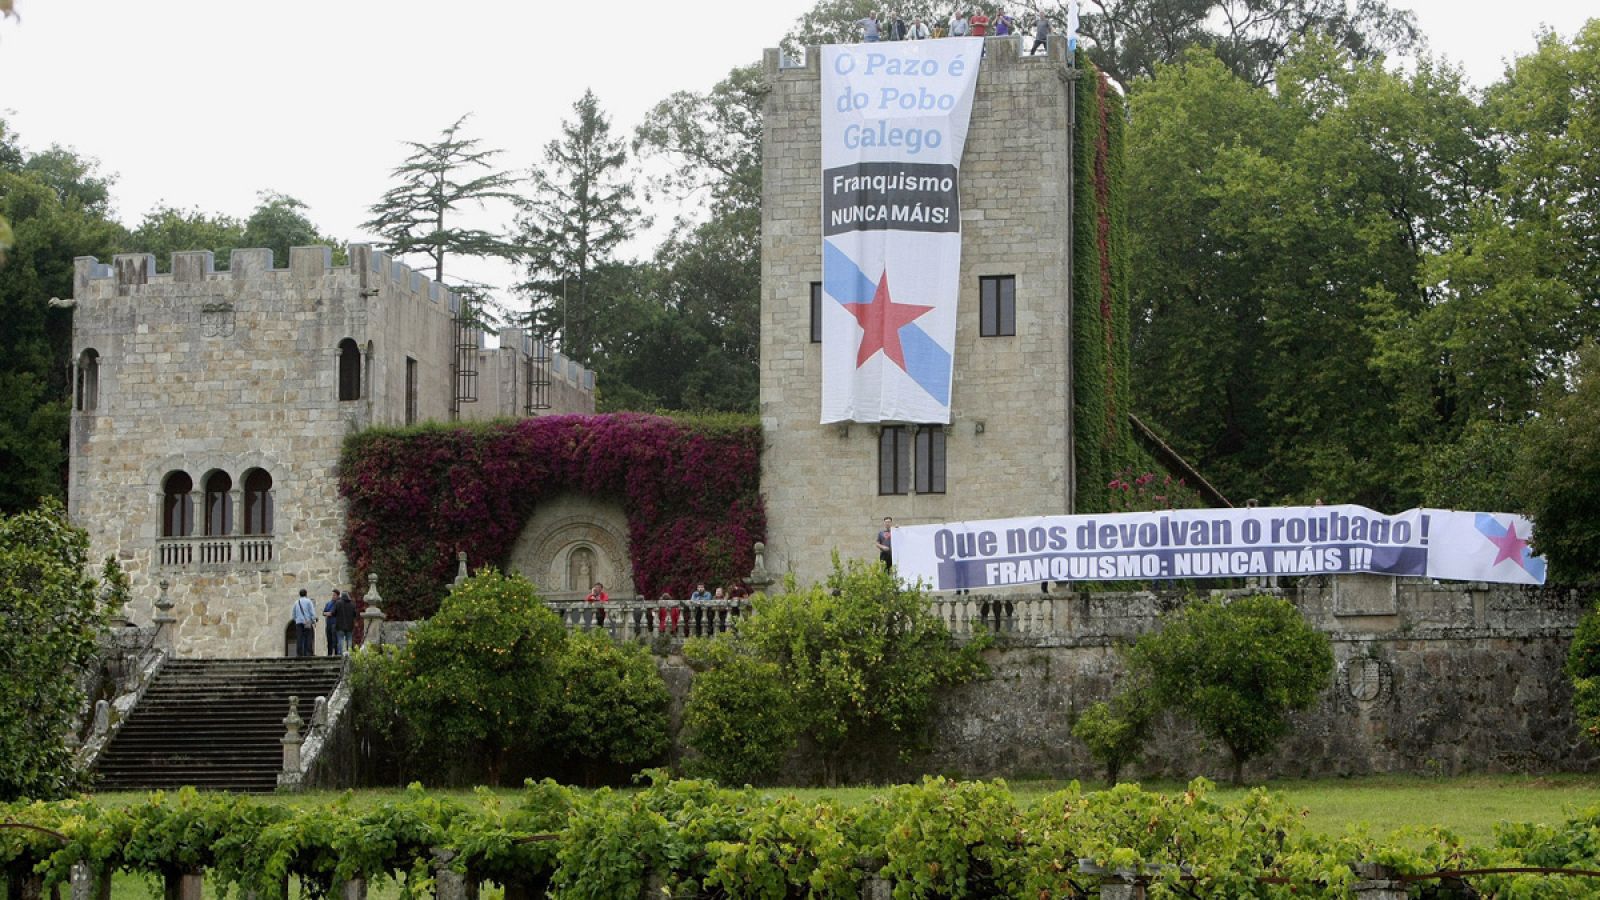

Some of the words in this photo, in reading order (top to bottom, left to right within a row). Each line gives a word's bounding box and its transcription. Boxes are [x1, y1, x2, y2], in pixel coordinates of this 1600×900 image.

[834, 53, 855, 76] O
[864, 53, 938, 76] Pazo
[948, 54, 965, 77] é
[837, 86, 869, 113] do
[878, 87, 955, 110] Pobo
[844, 120, 942, 154] Galego
[832, 172, 953, 194] Franquismo
[831, 204, 888, 226] NUNCA
[892, 202, 949, 224] MÁIS!
[934, 528, 998, 562] Que
[1006, 526, 1068, 554] nos
[1076, 516, 1232, 550] devolvan
[1240, 518, 1262, 544] o
[1270, 512, 1412, 545] roubado
[985, 555, 1168, 585] FRANQUISMO:
[1175, 551, 1270, 577] NUNCA
[1273, 547, 1342, 573] MÁIS
